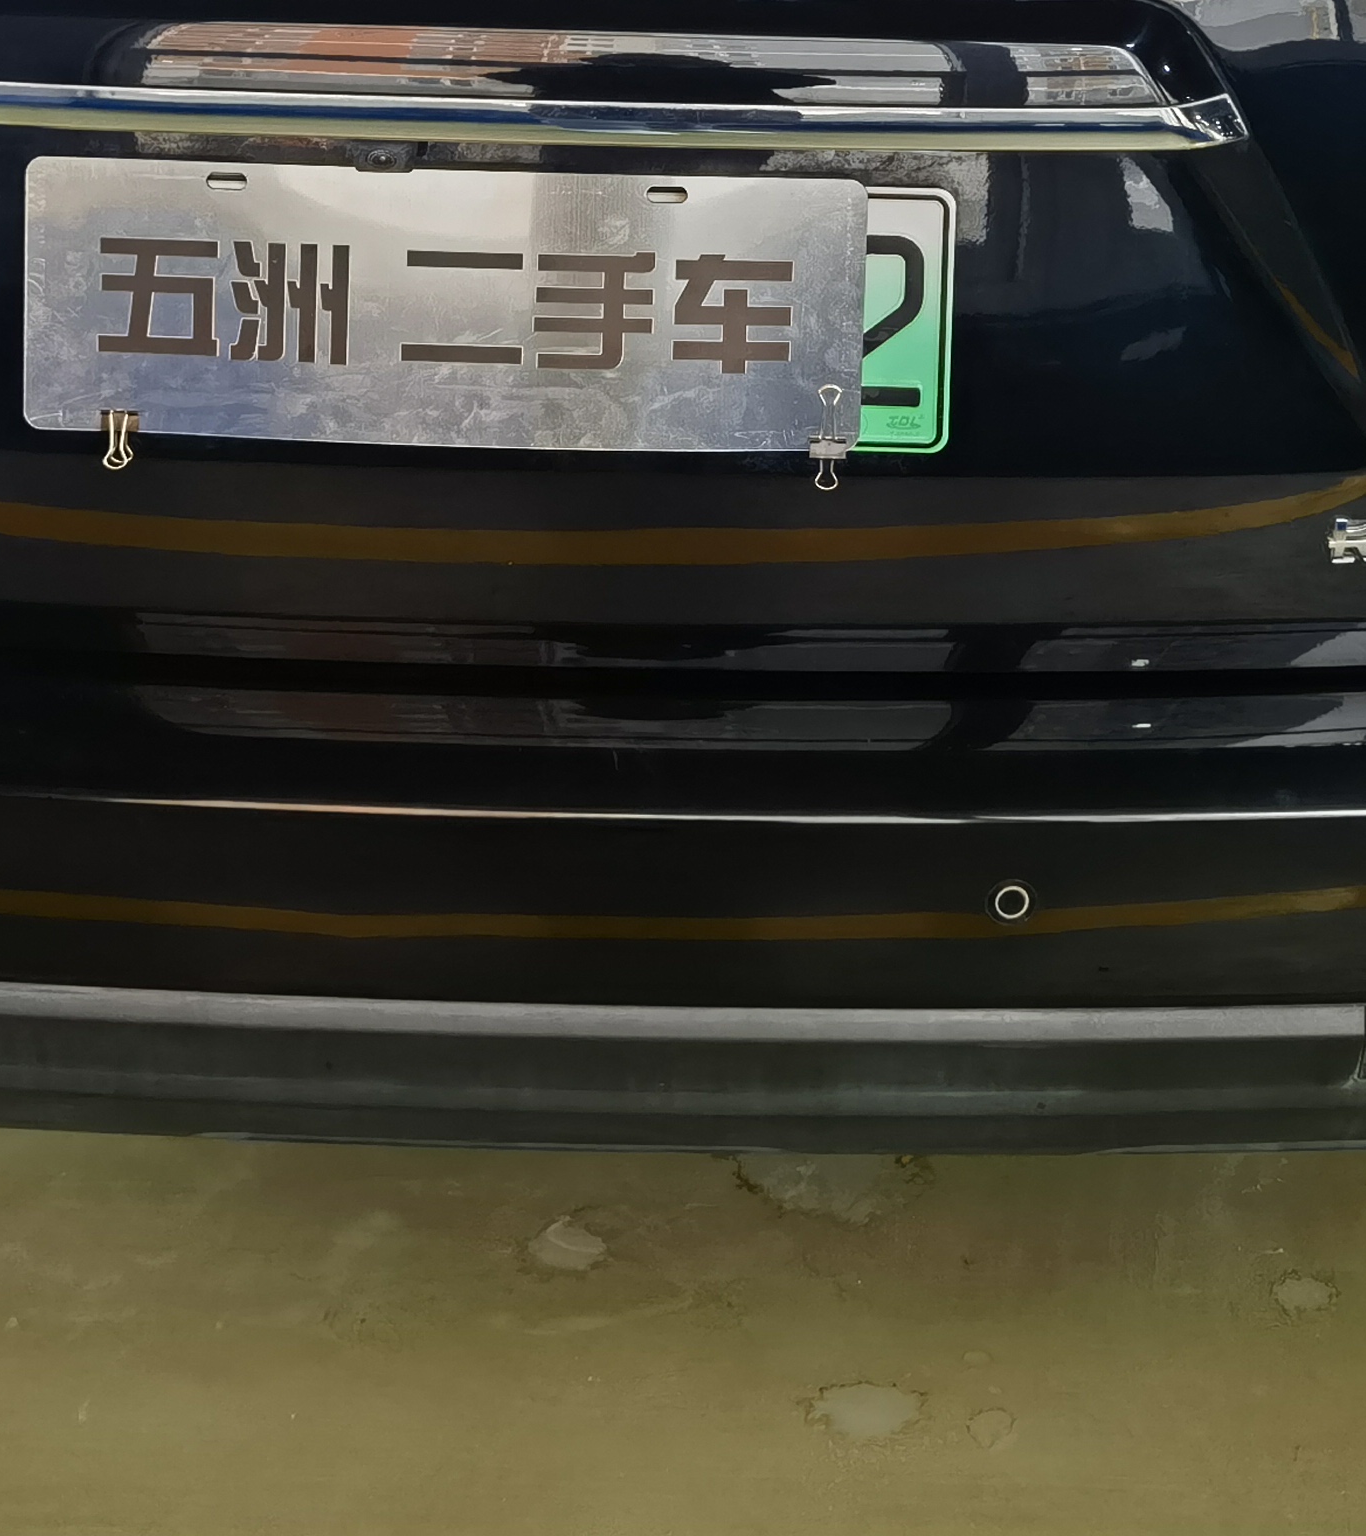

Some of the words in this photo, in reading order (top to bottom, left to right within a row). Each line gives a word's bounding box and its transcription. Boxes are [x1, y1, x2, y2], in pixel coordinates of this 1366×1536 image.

[98, 236, 351, 366] 五洲
[401, 250, 795, 375] 二手车
